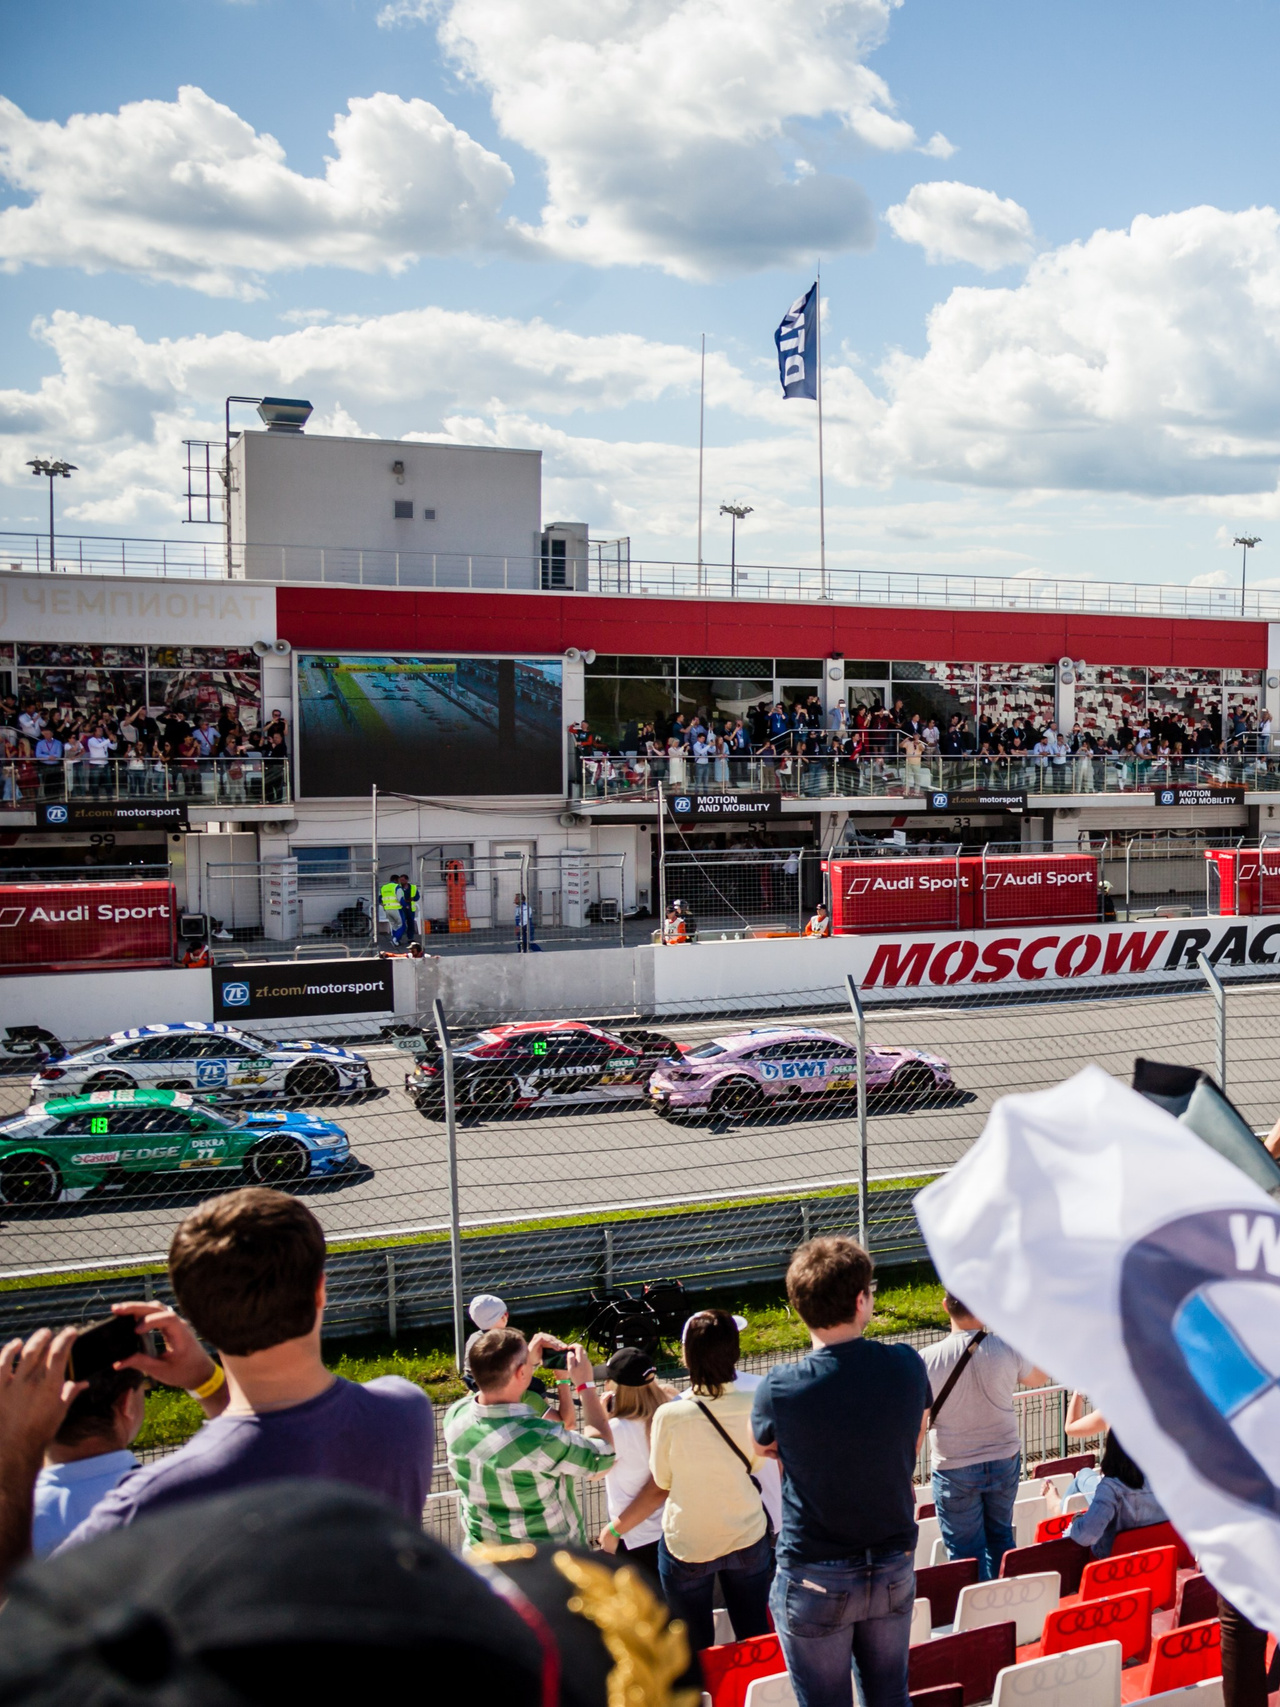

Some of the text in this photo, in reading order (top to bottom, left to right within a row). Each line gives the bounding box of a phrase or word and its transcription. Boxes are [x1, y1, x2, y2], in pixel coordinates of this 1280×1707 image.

[22, 587, 264, 620] ЧЕМПИОНАТ
[697, 796, 738, 804] MOTION
[75, 807, 181, 820] zf.com/motorsport
[697, 803, 770, 813] AND MOBILITY
[748, 821, 767, 832] 53
[954, 817, 971, 828] 33
[90, 833, 116, 847] 99
[872, 876, 969, 892] Audi Sport
[1003, 871, 1093, 886] Audi Sport
[29, 904, 170, 923] Audi Sport
[861, 930, 1169, 990] MOSCOW
[255, 980, 384, 998] zf.com/motorsport
[241, 1061, 270, 1069] DEKRA
[542, 1064, 601, 1078] PLAYBOY
[781, 1061, 827, 1079] BWT
[191, 1138, 225, 1148] DEKRA
[83, 1153, 118, 1164] Castrol
[120, 1146, 182, 1162] EDGE
